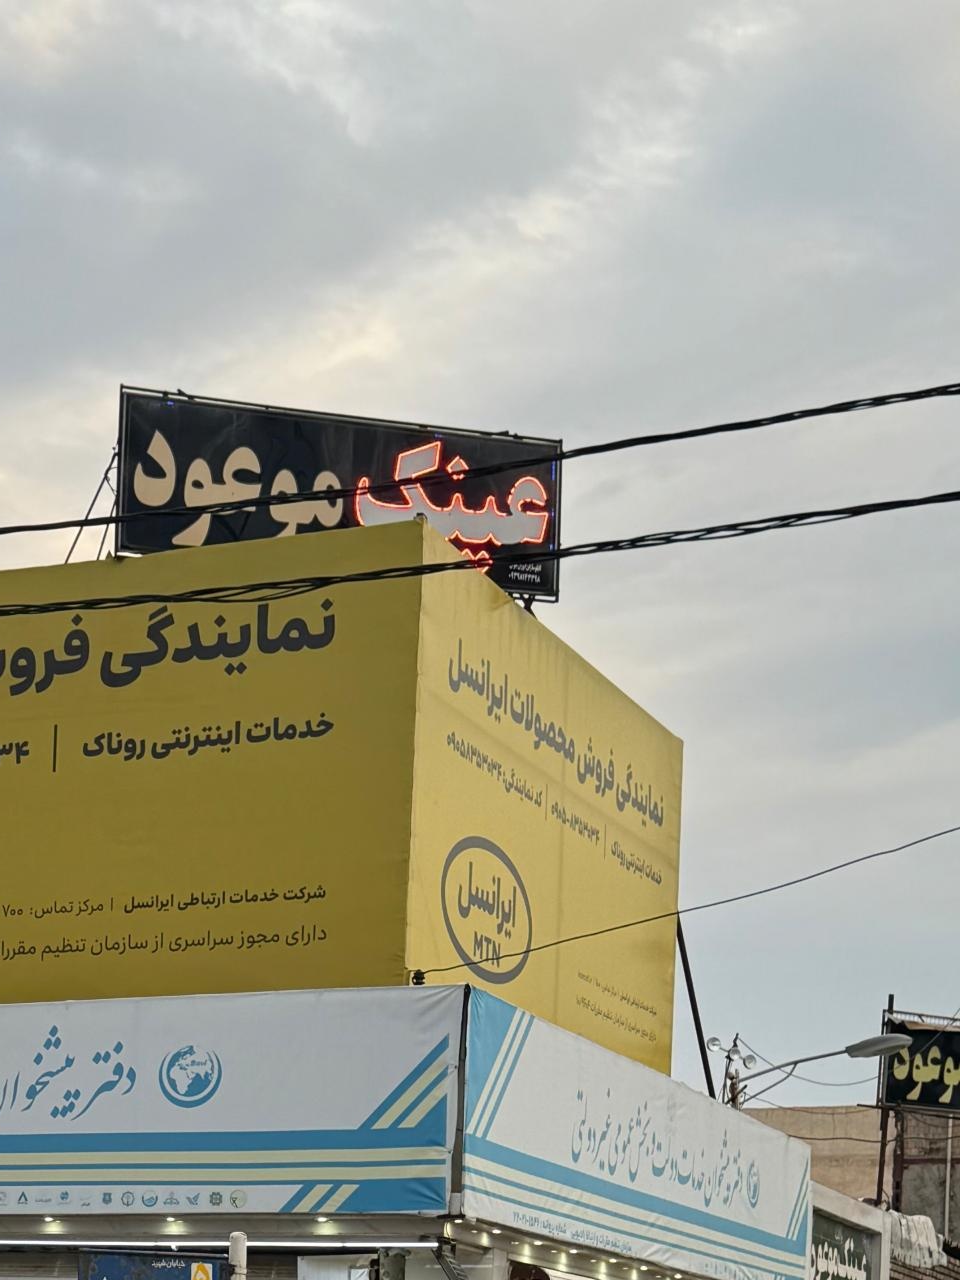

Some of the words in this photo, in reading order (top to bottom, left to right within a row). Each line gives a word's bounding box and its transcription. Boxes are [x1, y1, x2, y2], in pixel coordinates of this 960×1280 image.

[133, 428, 343, 547] موعود
[355, 441, 548, 573] عینک
[100, 598, 337, 688] نمایندگی
[448, 638, 508, 724] ایرانسل
[245, 712, 335, 743] خدمات
[510, 689, 575, 763] محصولات
[82, 731, 145, 761] روناک
[151, 721, 241, 759] اینترنتی
[577, 737, 615, 798] فروش
[534, 789, 543, 807] کد
[616, 763, 664, 827] نمایندگی
[76, 898, 105, 917] مرکز
[123, 894, 175, 915] ایرانسل
[177, 890, 226, 911] ارتباطی
[229, 887, 280, 905] خدمات
[282, 884, 327, 904] شرکت
[458, 862, 517, 940] ایرانسل
[2, 906, 25, 919] ۷۰۰
[28, 900, 74, 920] تماس:
[40, 936, 87, 961] تنظیم
[90, 932, 150, 957] سازمان
[153, 931, 164, 951] از
[169, 929, 234, 952] سراسری
[239, 932, 280, 951] مجوز
[285, 925, 328, 946] دارای
[473, 930, 501, 968] MTN
[71, 1041, 137, 1121] دفتر
[893, 1046, 960, 1103] وعود
